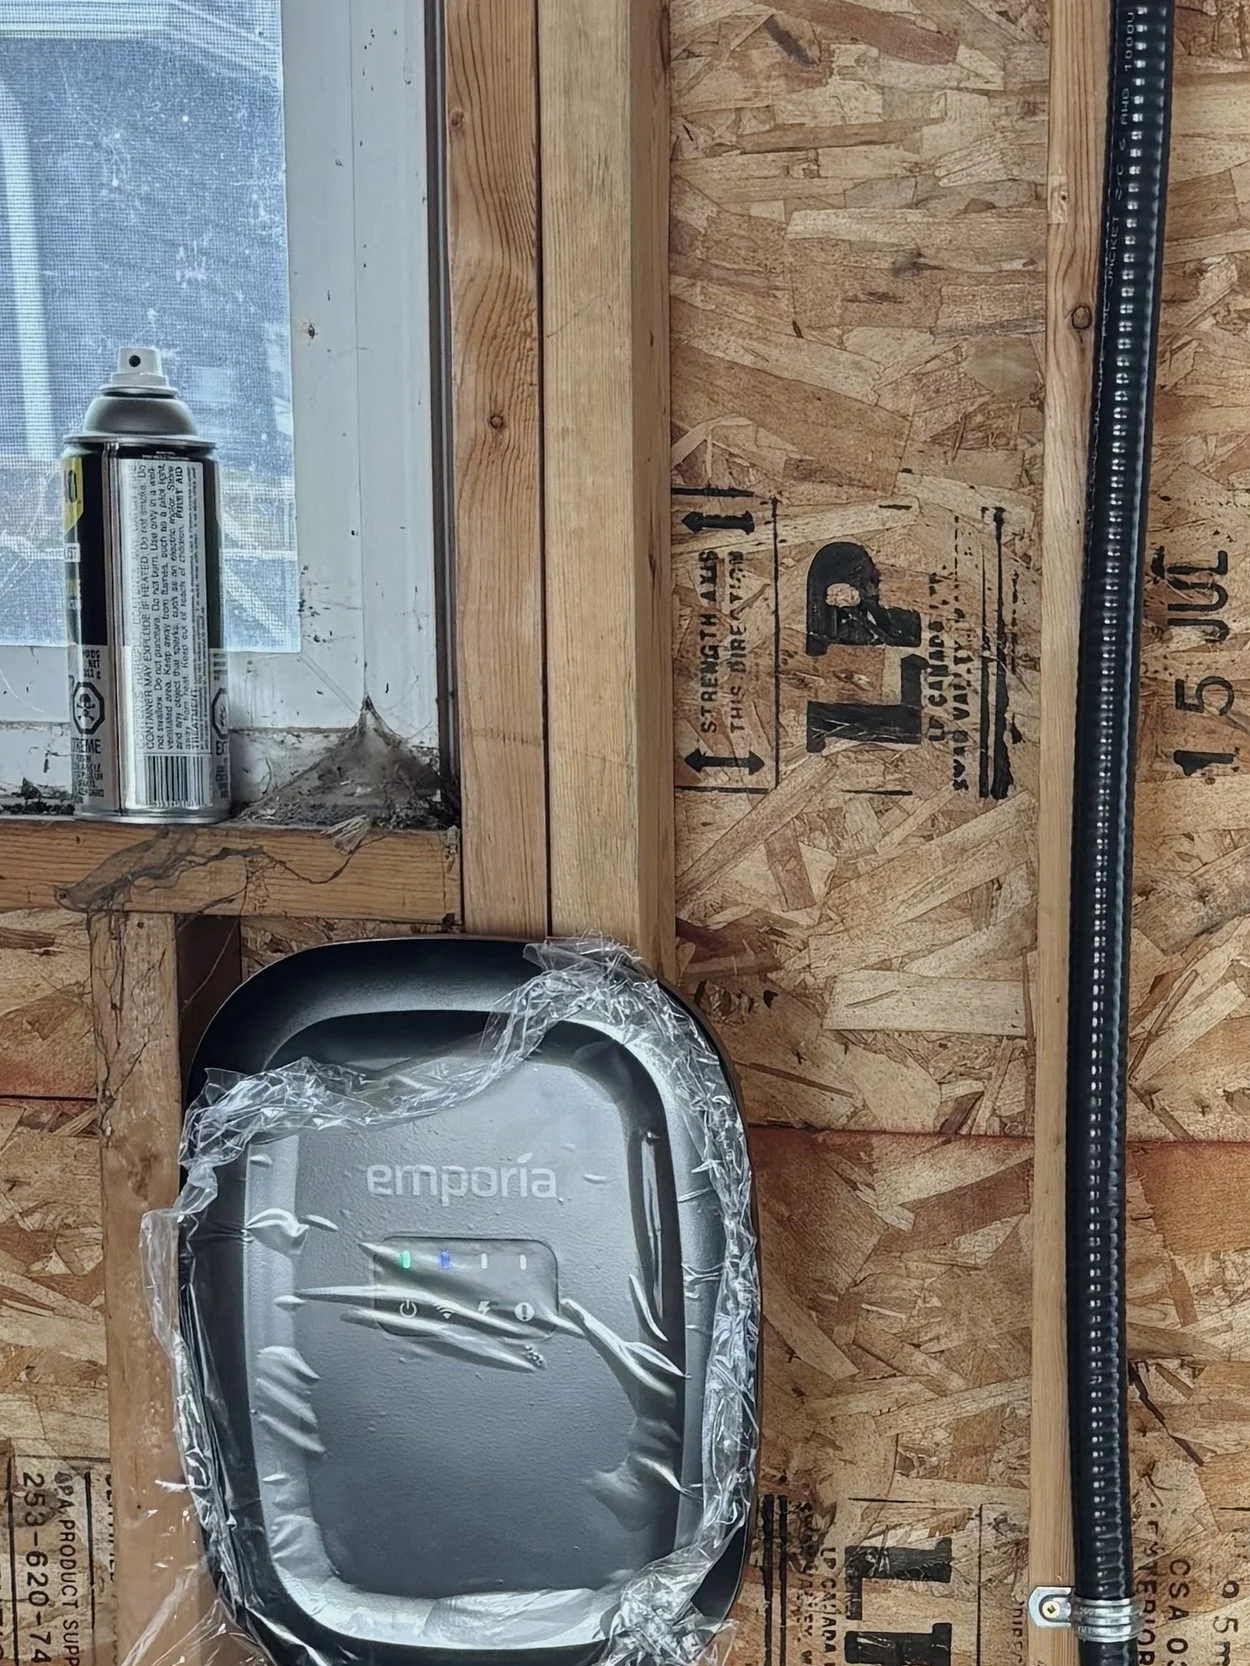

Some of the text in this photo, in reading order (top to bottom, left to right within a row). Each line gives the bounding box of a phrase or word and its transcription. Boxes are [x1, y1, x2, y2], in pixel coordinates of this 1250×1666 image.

[699, 550, 719, 734] STRENGTH AXIS
[1166, 550, 1230, 643] JUL
[805, 541, 928, 754] LP
[730, 685, 746, 734] THIS
[59, 1518, 79, 1611] PRODUCT
[1167, 1558, 1191, 1621] CSA
[820, 1579, 837, 1660] CANADA
